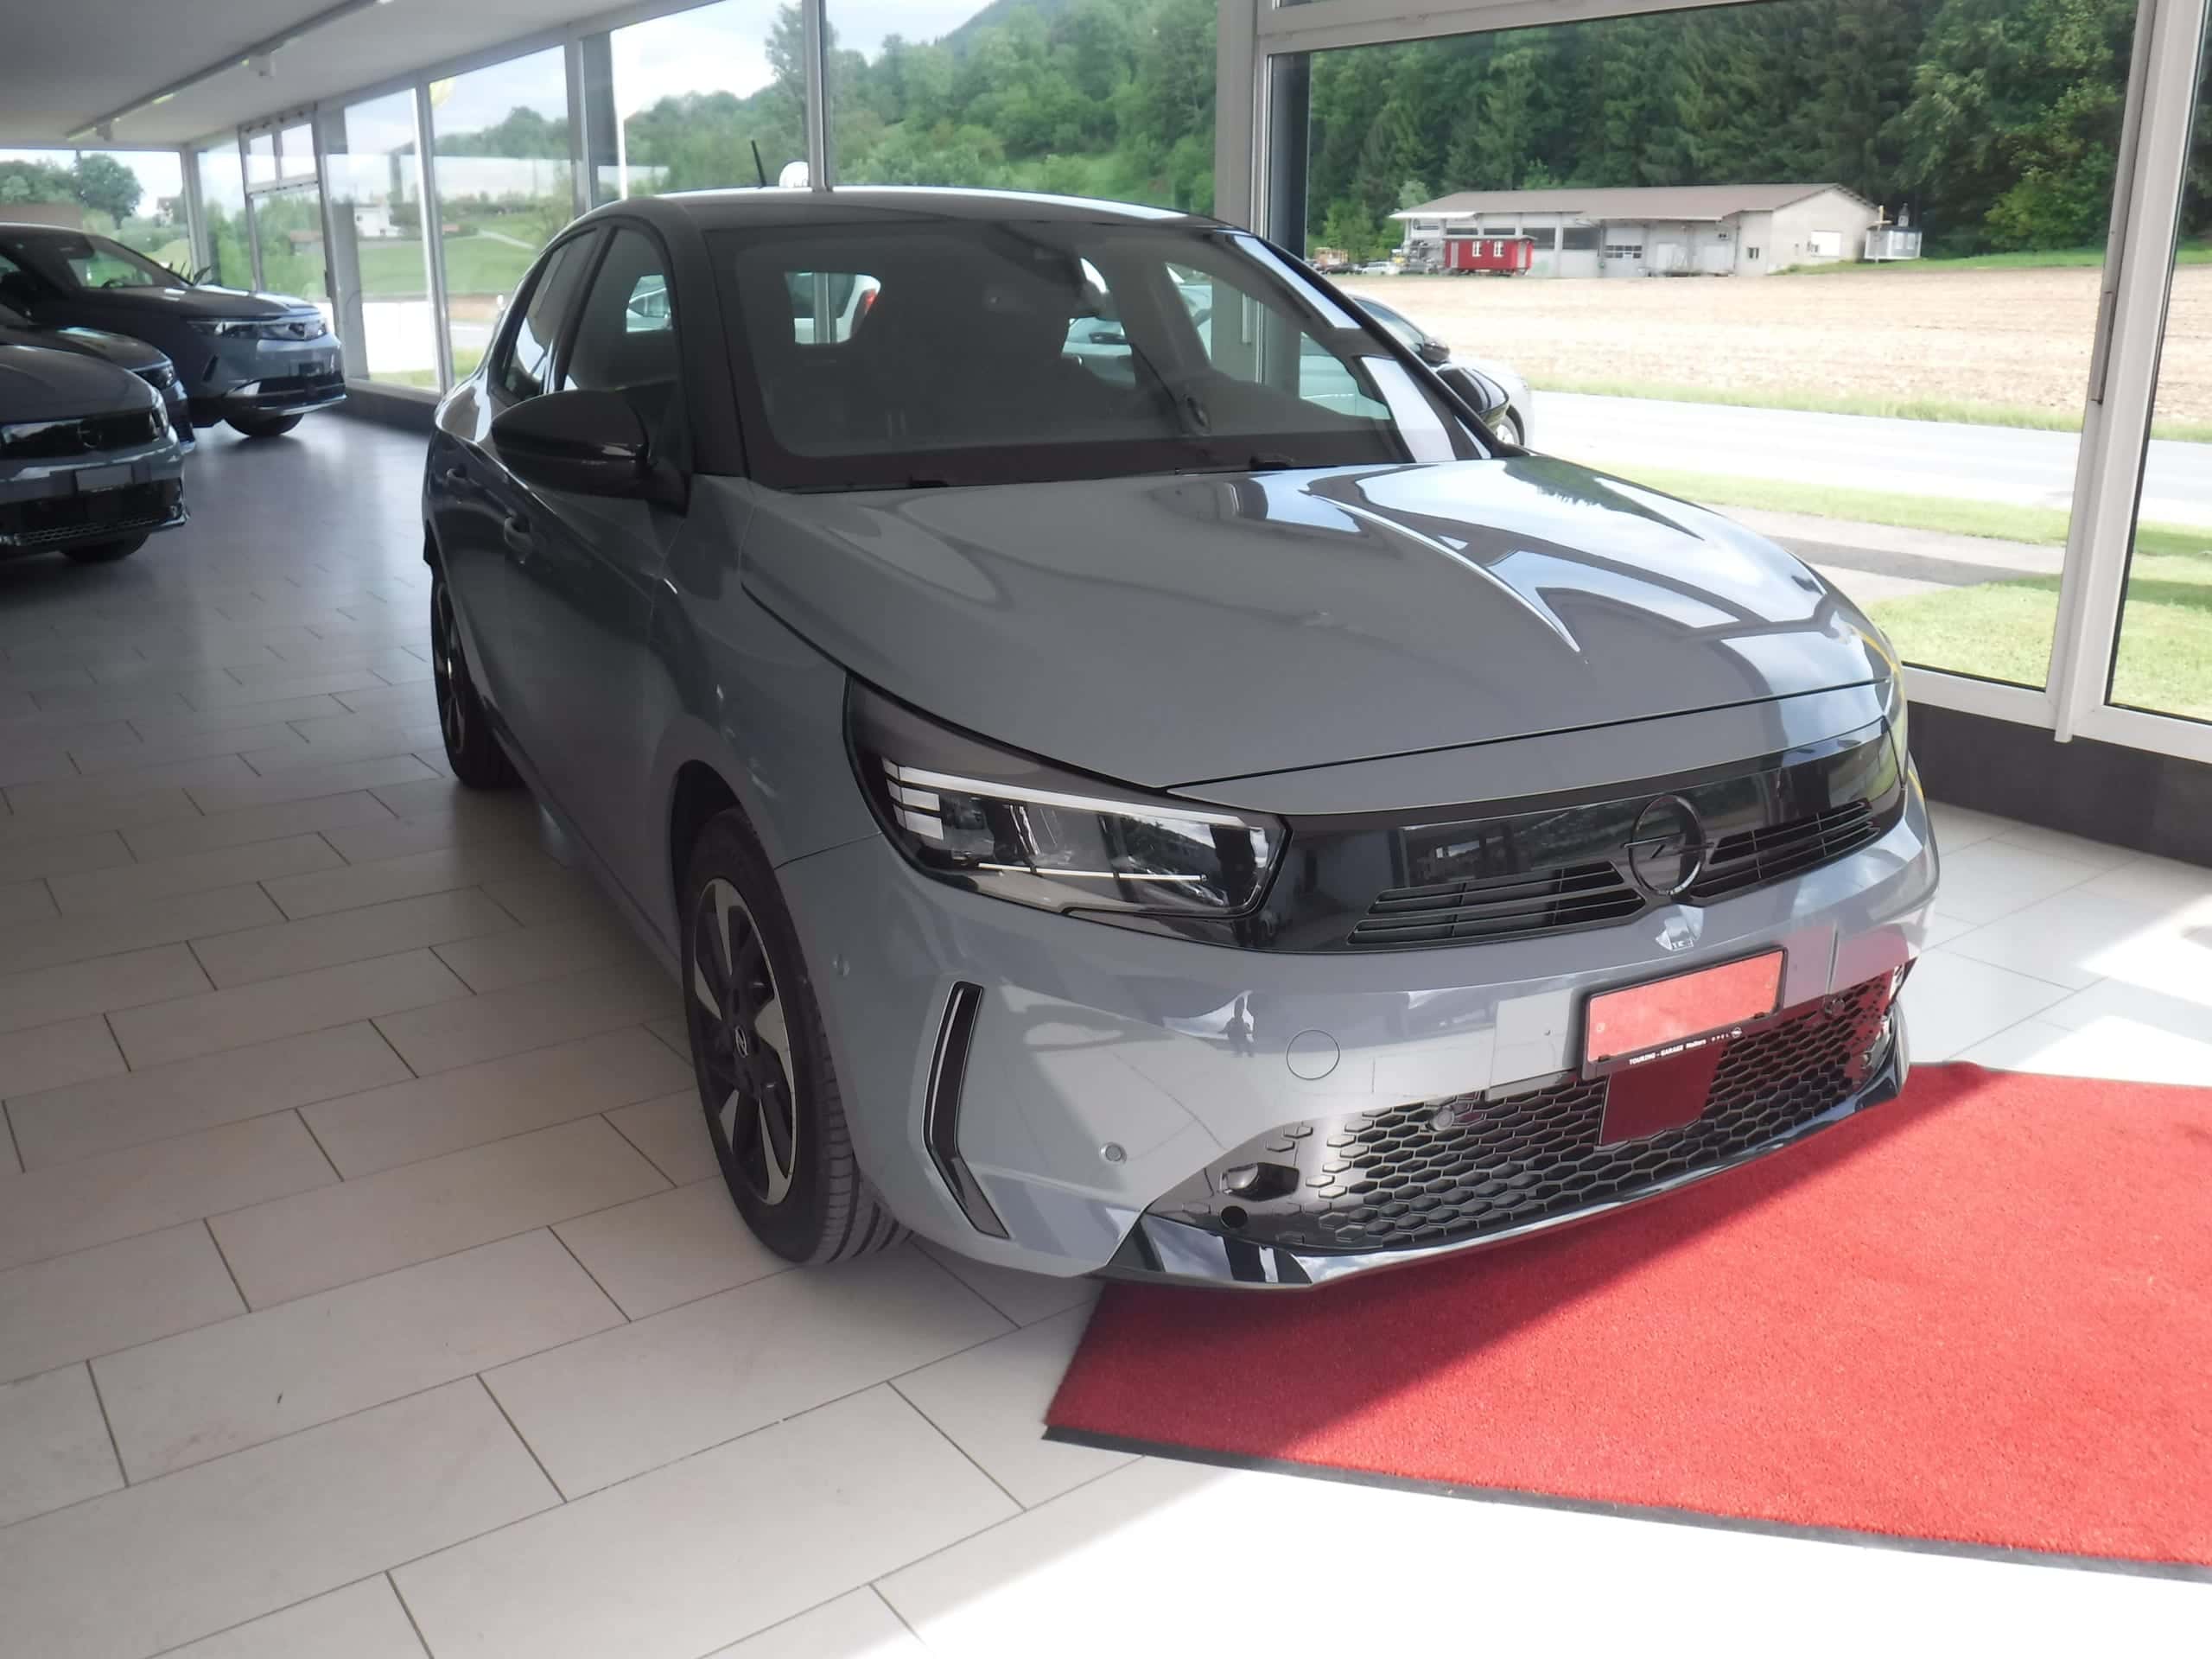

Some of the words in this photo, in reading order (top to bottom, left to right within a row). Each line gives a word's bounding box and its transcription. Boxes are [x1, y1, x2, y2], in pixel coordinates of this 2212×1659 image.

[1629, 1052, 1656, 1065] TOURING
[1660, 1045, 1684, 1057] GARAGE
[1711, 1033, 1729, 1042] OPEL
